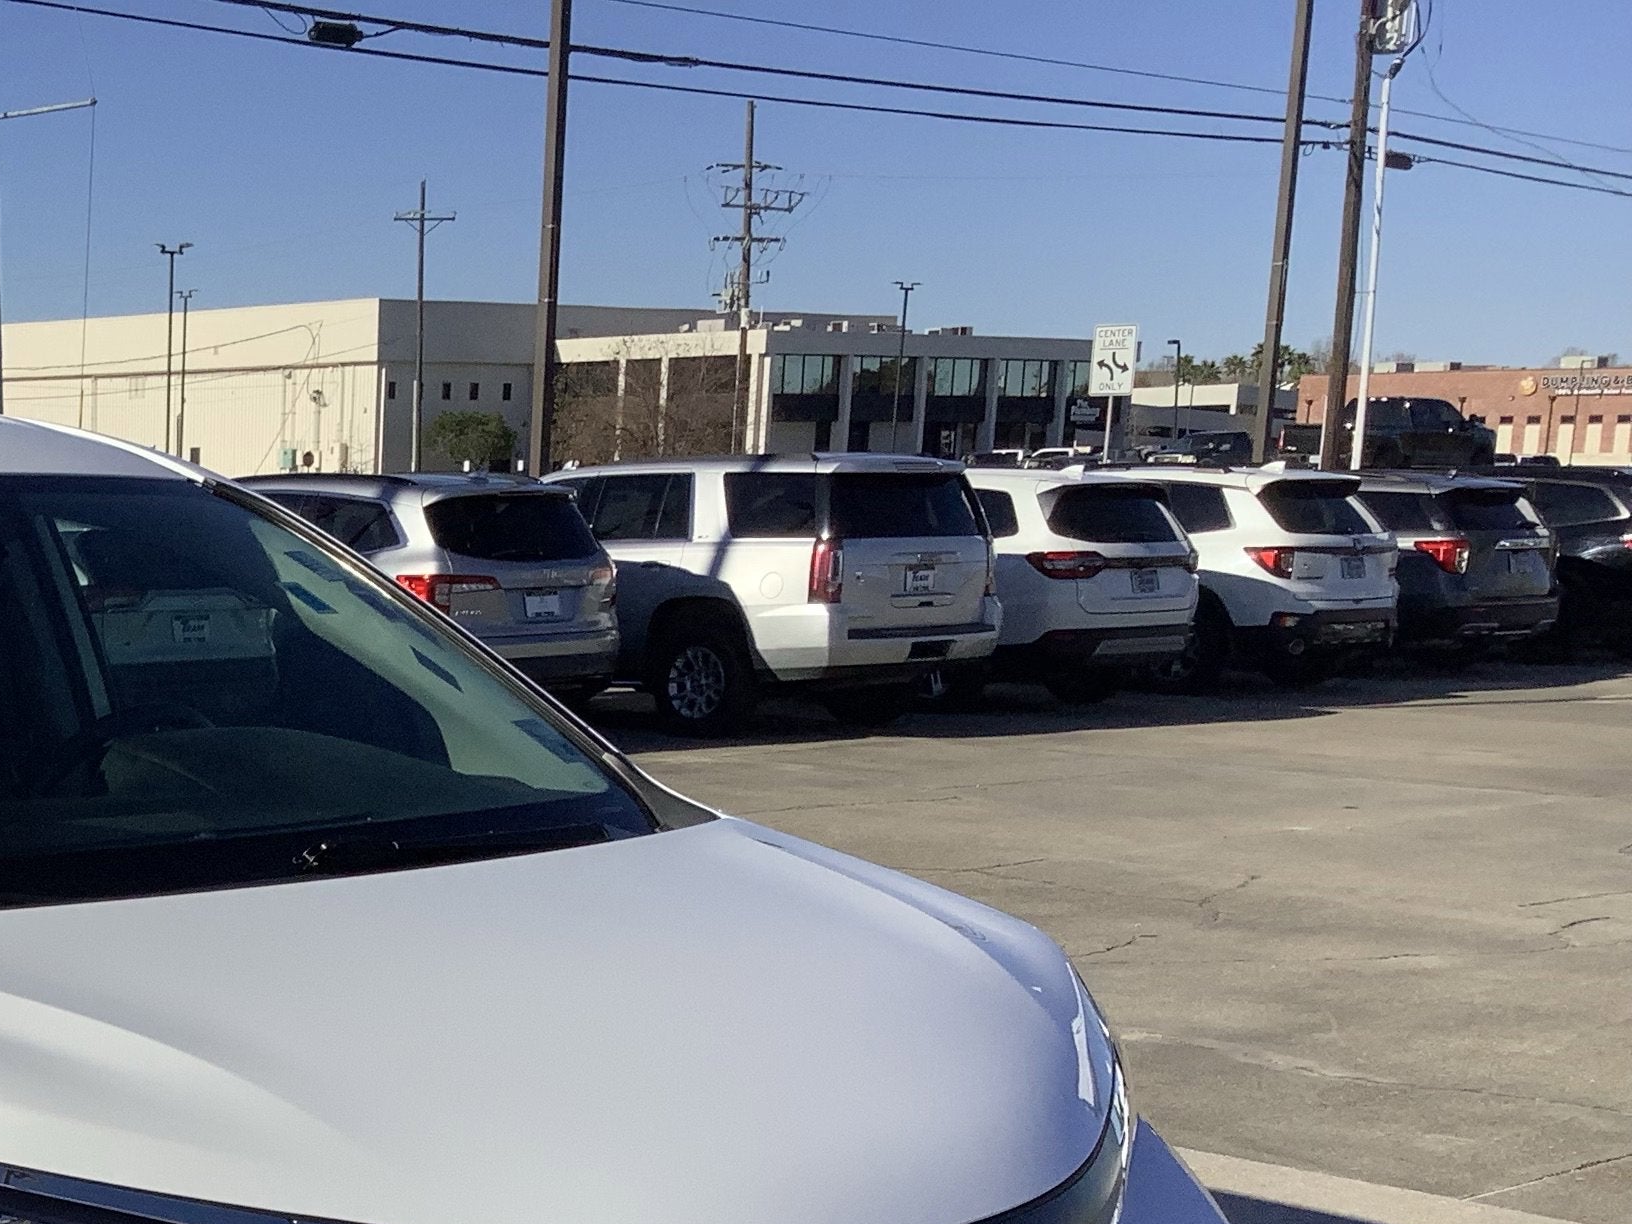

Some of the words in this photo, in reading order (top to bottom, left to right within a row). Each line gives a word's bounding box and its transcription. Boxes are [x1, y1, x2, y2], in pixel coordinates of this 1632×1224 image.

[1098, 328, 1134, 338] CENTER
[1102, 338, 1128, 347] LANE
[1098, 382, 1124, 391] ONLY
